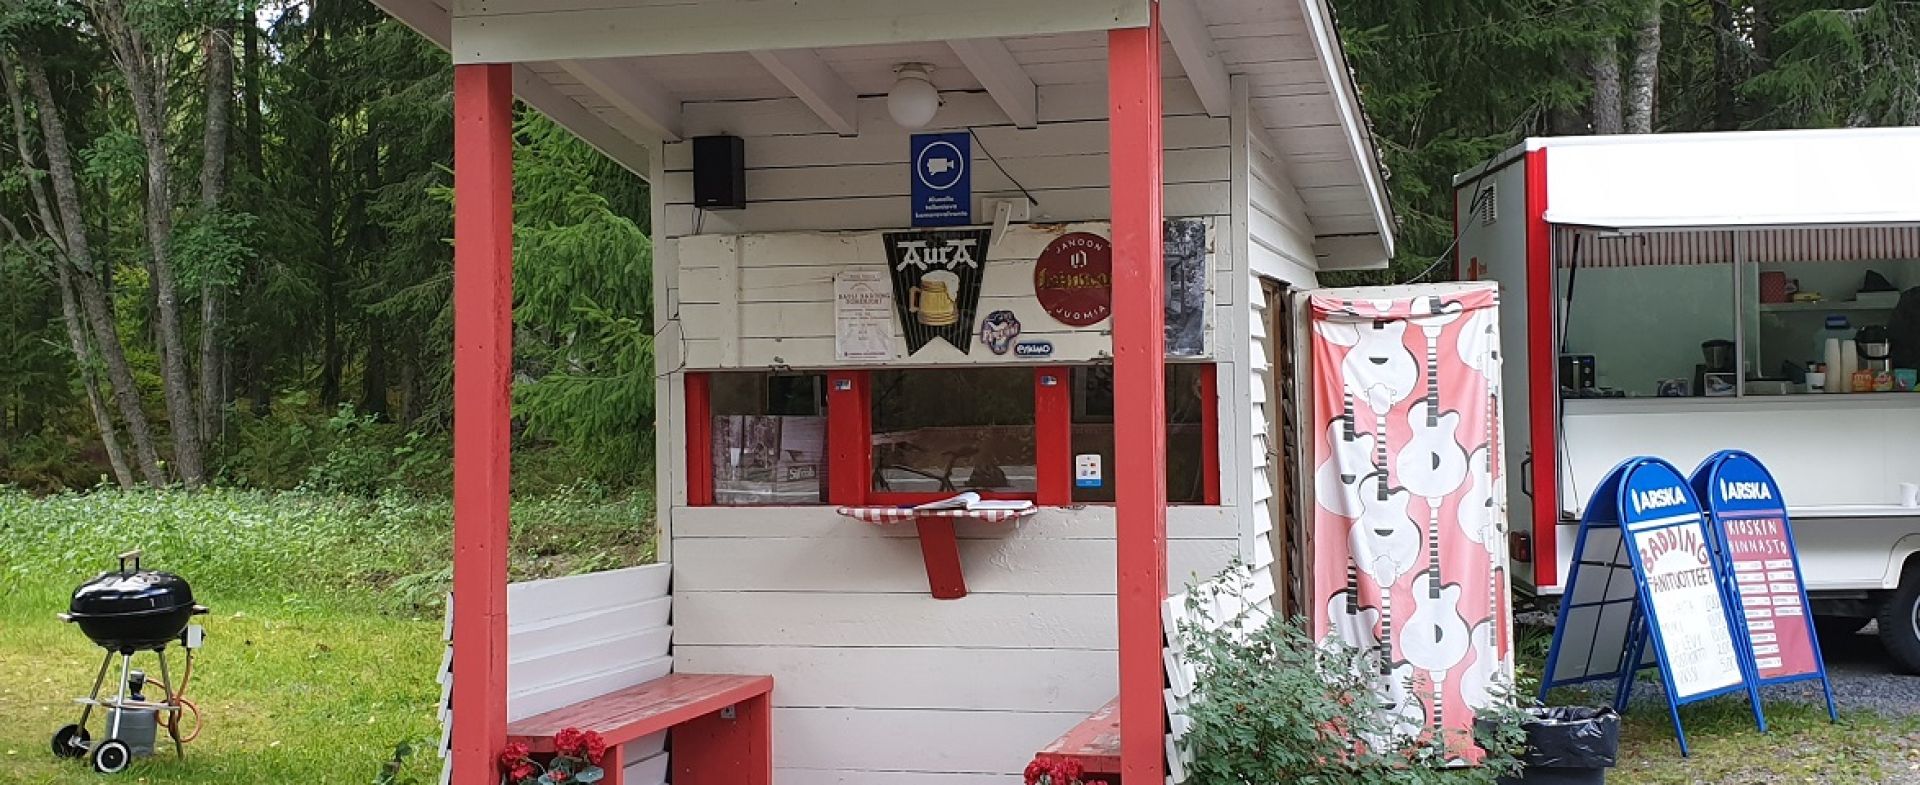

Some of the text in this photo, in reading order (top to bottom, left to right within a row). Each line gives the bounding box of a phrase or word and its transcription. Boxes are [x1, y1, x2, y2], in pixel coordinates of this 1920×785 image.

[1056, 238, 1103, 254] JANOON
[1056, 305, 1106, 320] JUOMIA
[1640, 485, 1687, 511] ARSKA
[1727, 481, 1772, 500] ARSKA
[1725, 519, 1778, 536] KIOSKIN
[1640, 524, 1709, 574] BADDING
